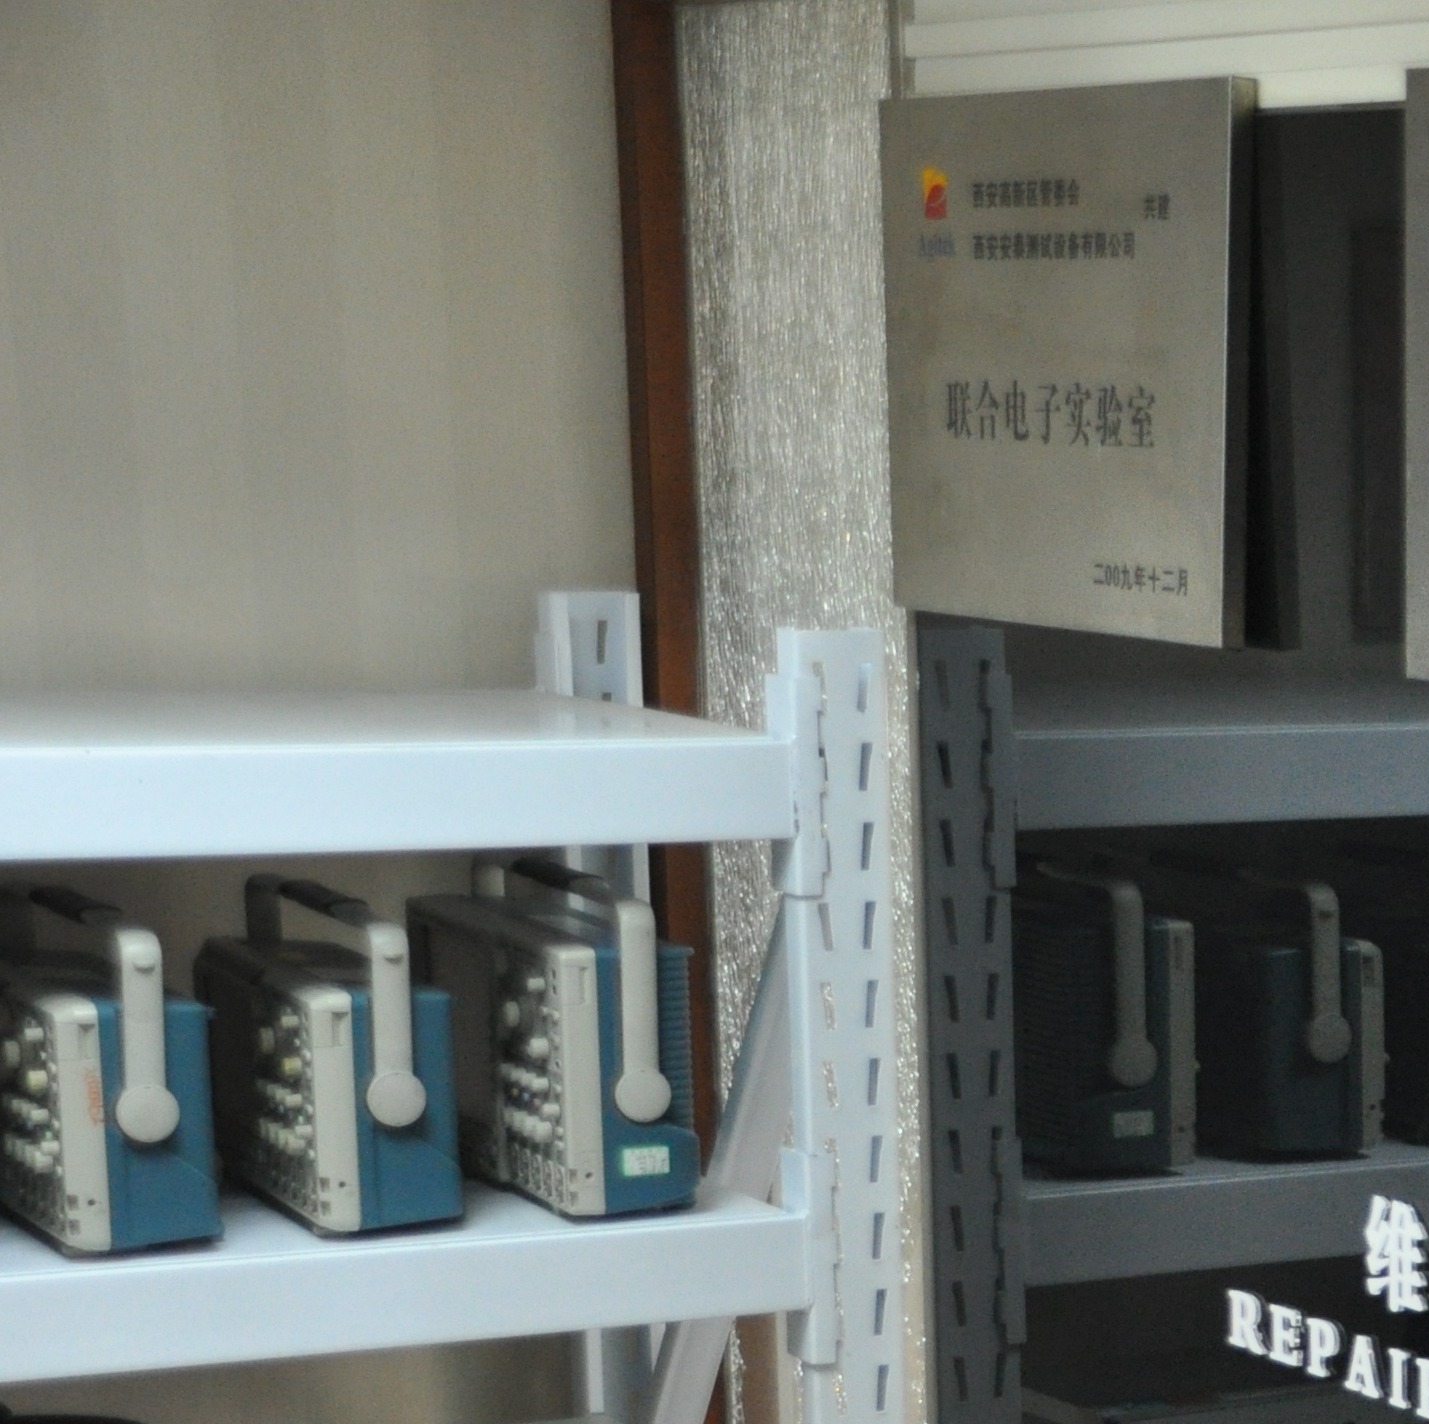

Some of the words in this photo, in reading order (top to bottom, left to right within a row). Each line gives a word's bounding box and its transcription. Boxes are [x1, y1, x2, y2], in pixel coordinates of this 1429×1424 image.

[946, 379, 1157, 451] 联合电子实验室
